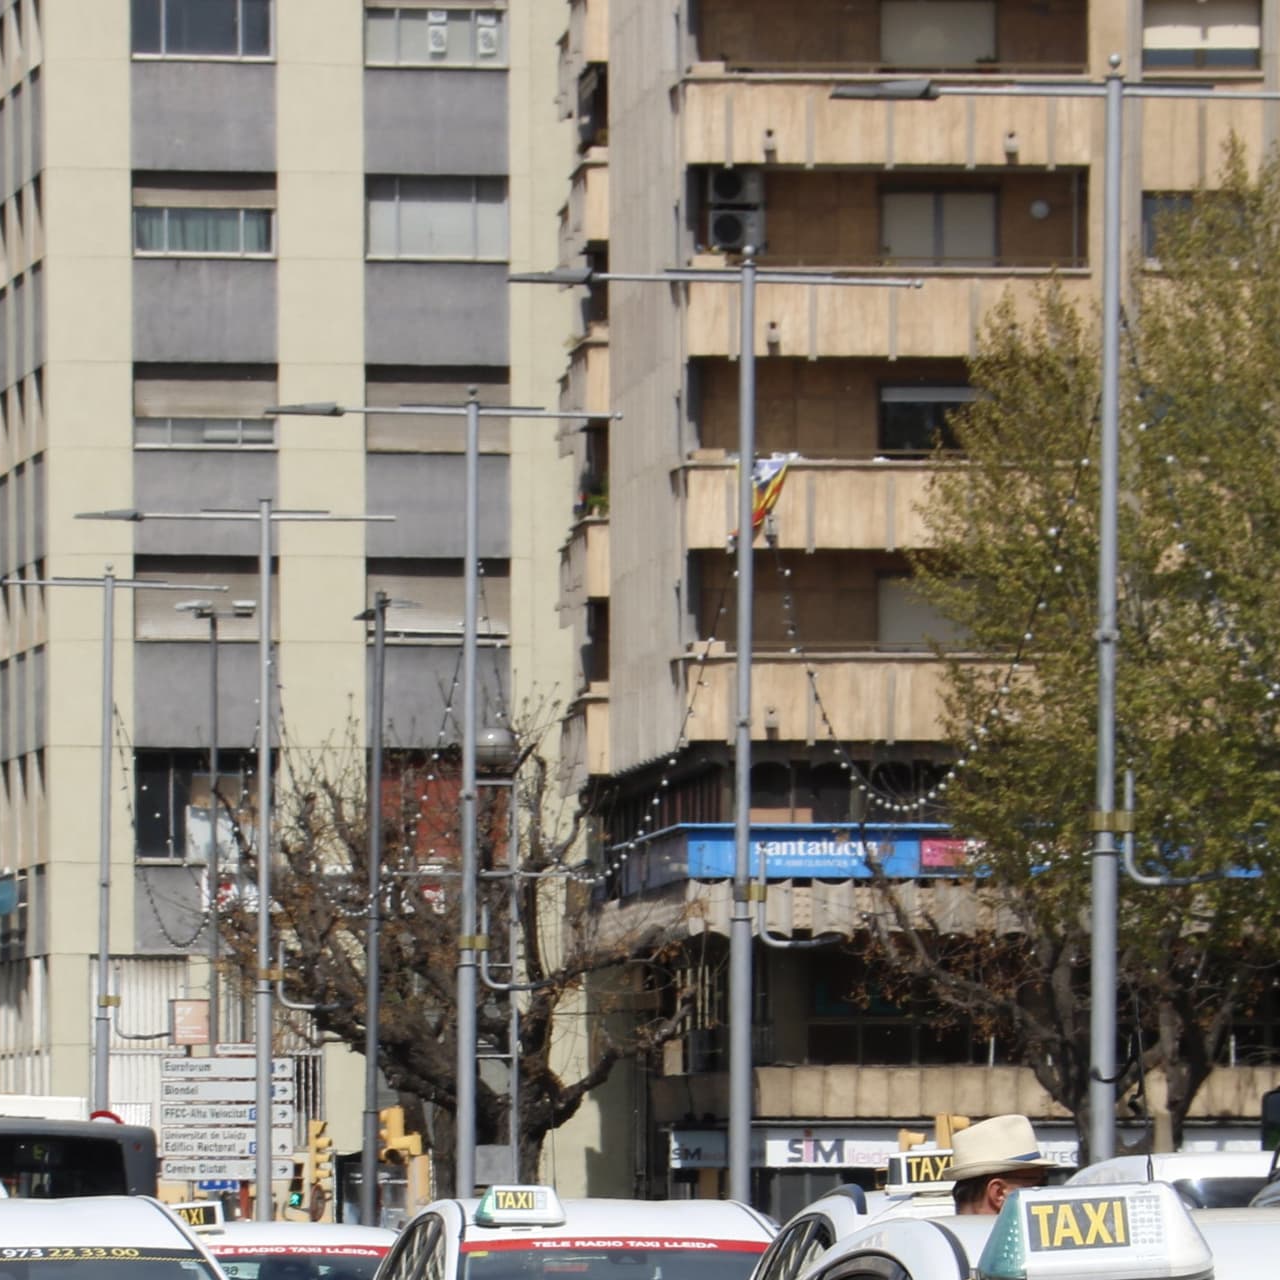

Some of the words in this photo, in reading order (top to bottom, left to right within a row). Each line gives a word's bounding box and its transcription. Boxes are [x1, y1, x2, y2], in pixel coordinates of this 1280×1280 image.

[497, 1191, 534, 1209] TAXI
[1031, 1201, 1126, 1247] TAXI
[532, 1241, 571, 1249] TELE
[574, 1240, 623, 1248] RADIO
[626, 1240, 660, 1248] TAXI
[664, 1241, 719, 1249] LLEIDA
[2, 1248, 45, 1258] 973
[47, 1248, 77, 1258] 22
[79, 1248, 107, 1257] 33
[110, 1248, 140, 1258] 00
[238, 1246, 287, 1255] RADIO
[288, 1246, 322, 1254] TAXI
[324, 1247, 380, 1257] LLEIDA
